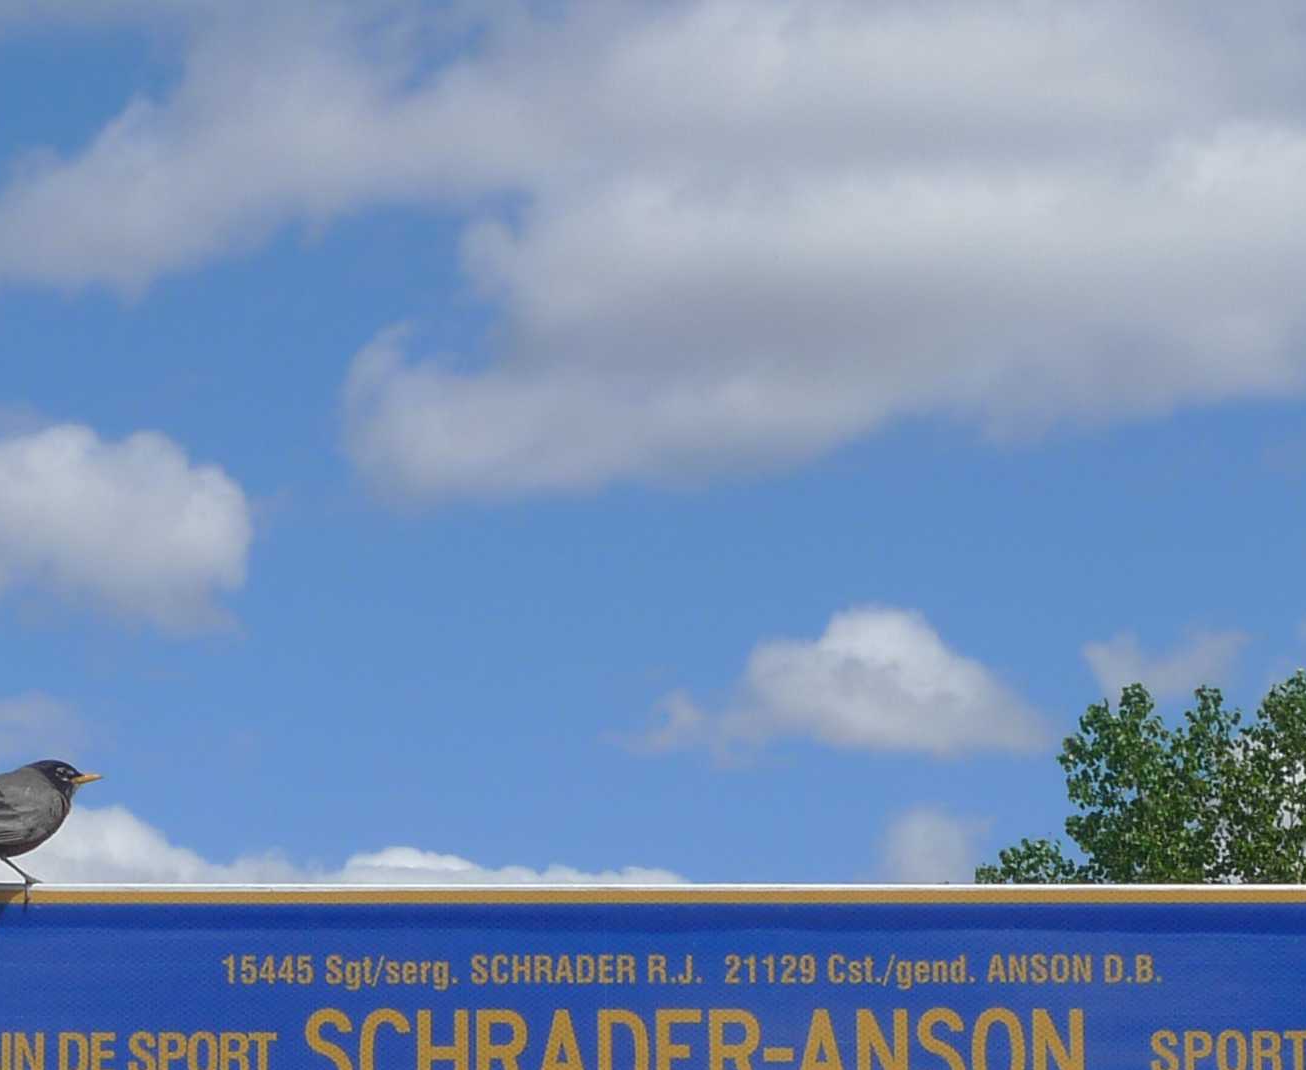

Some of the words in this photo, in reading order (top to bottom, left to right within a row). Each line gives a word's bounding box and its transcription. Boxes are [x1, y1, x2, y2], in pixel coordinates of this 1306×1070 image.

[224, 954, 315, 985] 15445
[325, 953, 459, 991] Sgt/serg.
[470, 953, 638, 985] SCHRADER
[648, 953, 702, 985] R.J.
[724, 953, 817, 984] 21129
[827, 953, 976, 991] Cst./gend.
[987, 952, 1094, 984] ANSON
[1104, 953, 1161, 984] D.B.
